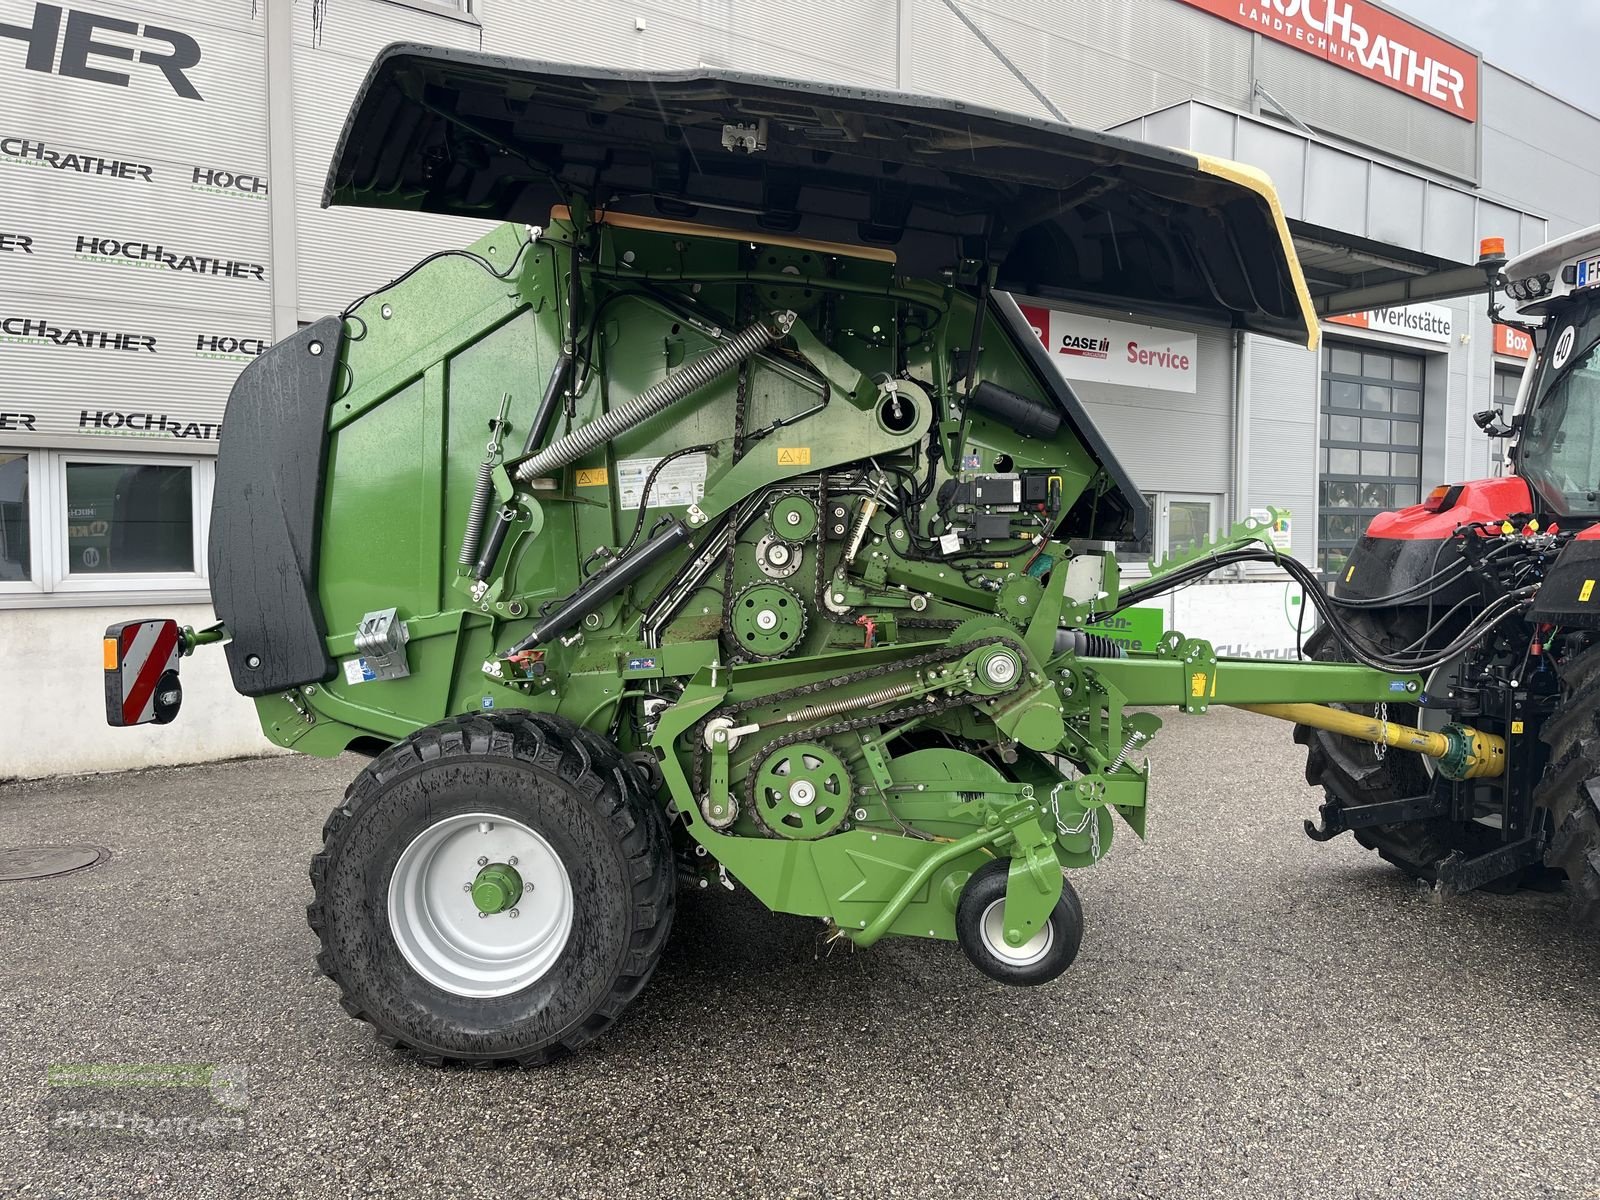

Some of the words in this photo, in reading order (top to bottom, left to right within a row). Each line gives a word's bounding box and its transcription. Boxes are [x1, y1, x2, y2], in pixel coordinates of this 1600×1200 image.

[1239, 3, 1355, 62] LANDTECHNIK
[0, 138, 153, 182] CHRATHER
[75, 235, 265, 281] HOCHRATHER
[0, 317, 157, 353] CHRATHER
[1373, 307, 1451, 336] Werkstätte
[1062, 334, 1098, 351] CASE
[1505, 328, 1528, 352] Box
[1556, 335, 1568, 361] 40
[1127, 341, 1190, 370] Service
